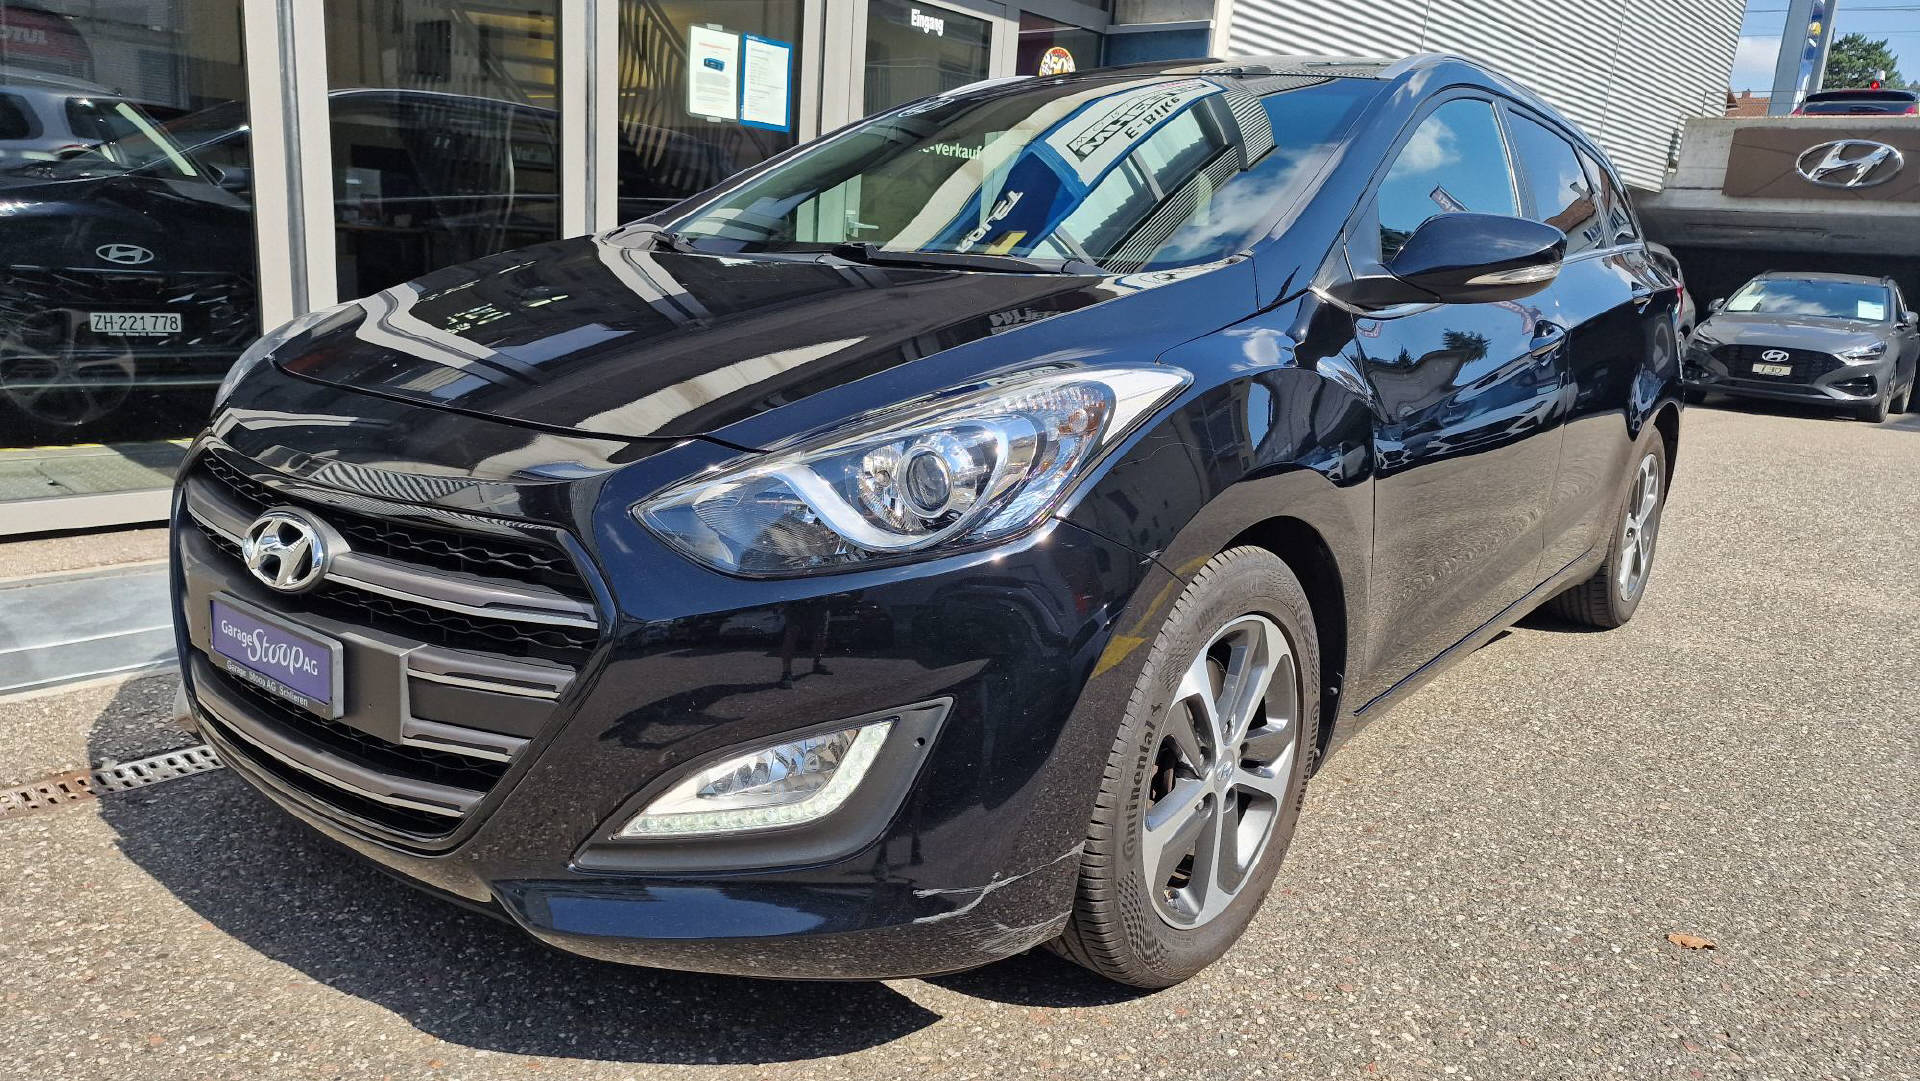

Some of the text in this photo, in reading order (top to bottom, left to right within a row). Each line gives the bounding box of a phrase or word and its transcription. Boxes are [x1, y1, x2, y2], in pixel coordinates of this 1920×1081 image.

[911, 8, 944, 36] Eingang
[918, 142, 982, 160] -verkauf
[221, 620, 318, 675] Garage Stoop AG
[226, 660, 247, 677] Garage
[266, 679, 277, 692] AG
[1122, 720, 1156, 859] Continental
